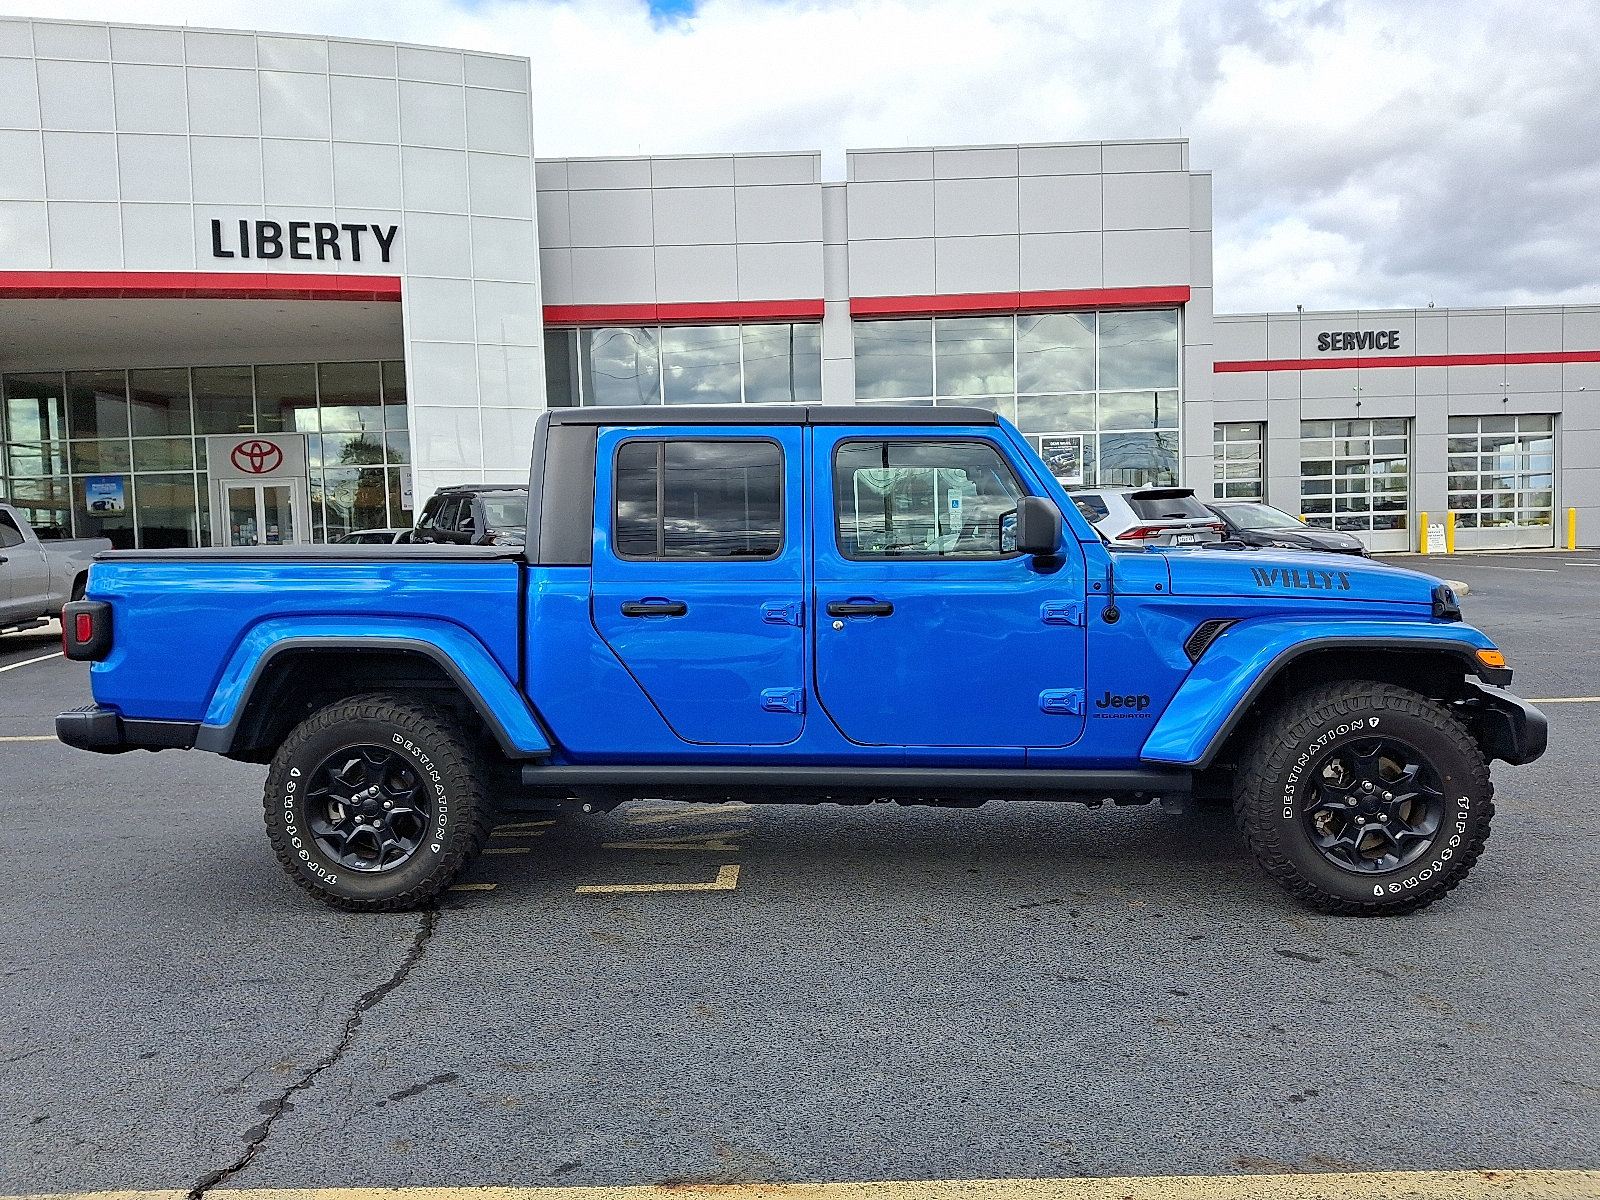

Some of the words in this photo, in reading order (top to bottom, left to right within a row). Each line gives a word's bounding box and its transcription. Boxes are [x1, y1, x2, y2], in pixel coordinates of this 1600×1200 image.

[211, 219, 398, 262] LIBERTY
[1317, 330, 1400, 351] SERVICE
[1249, 567, 1351, 590] WILLYS
[1095, 691, 1151, 711] Jeep
[1283, 718, 1364, 819] DESTINATION
[392, 733, 448, 840] DESTINATION
